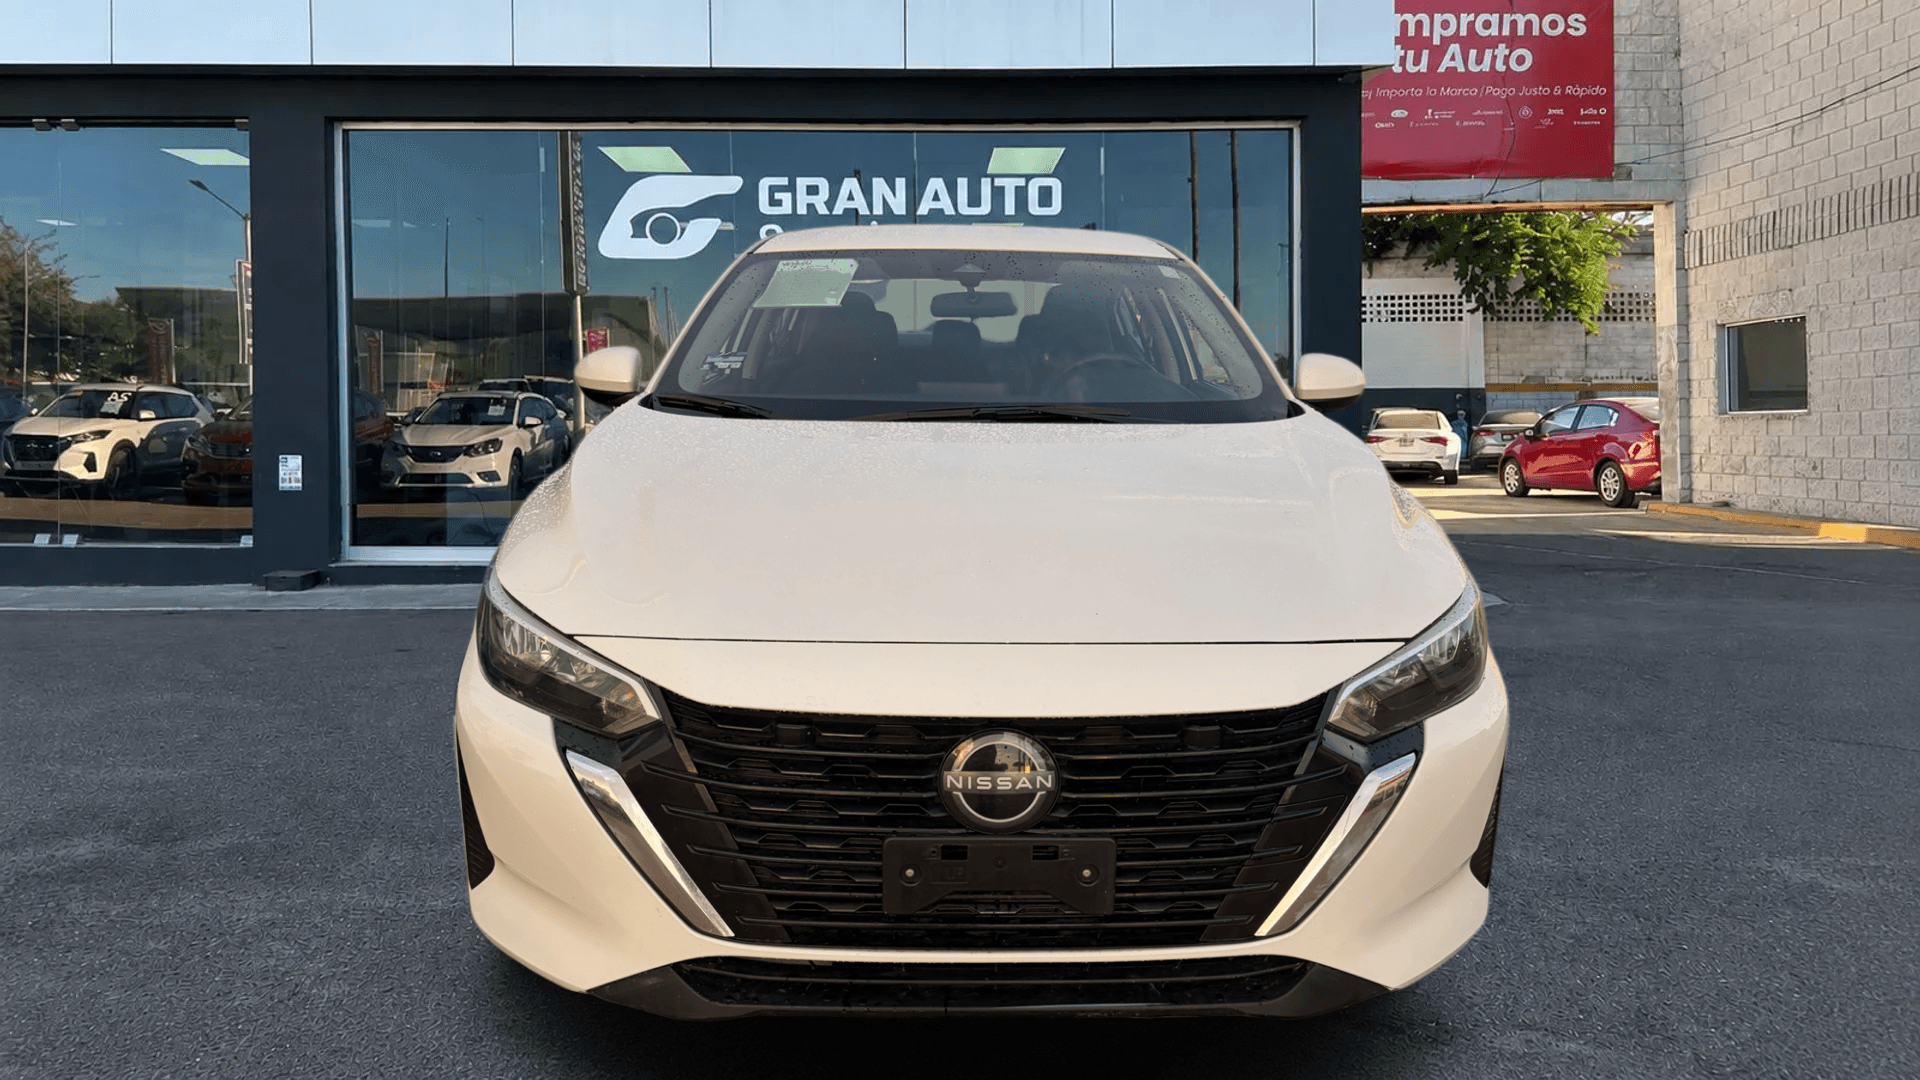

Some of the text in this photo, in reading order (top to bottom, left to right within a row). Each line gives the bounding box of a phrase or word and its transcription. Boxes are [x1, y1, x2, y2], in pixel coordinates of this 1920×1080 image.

[1391, 43, 1533, 73] tu Auto
[1376, 87, 1423, 99] Importa
[1426, 86, 1437, 96] la
[1440, 86, 1478, 97] Marca
[1519, 85, 1551, 96] Justo
[1553, 85, 1562, 96] &
[758, 176, 1063, 216] GRAN AUTO
[946, 774, 1052, 790] NISSAN
